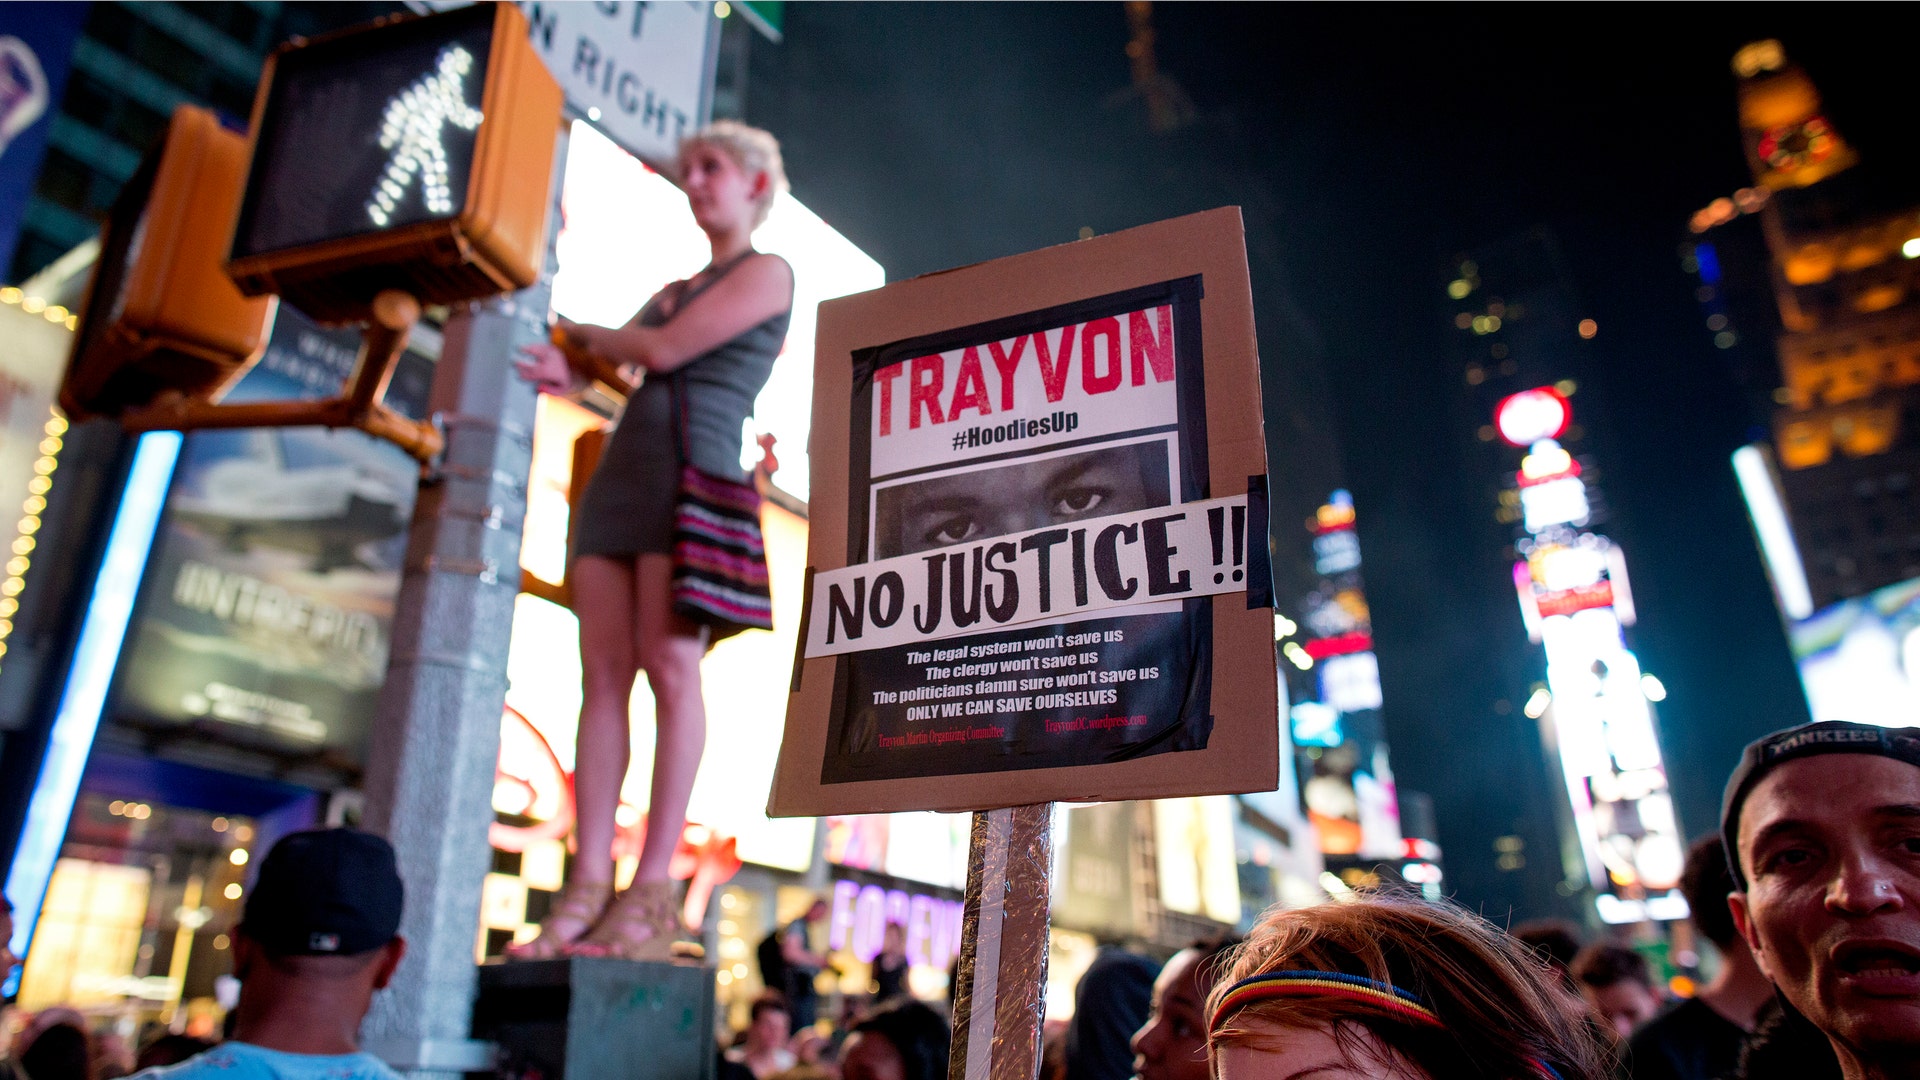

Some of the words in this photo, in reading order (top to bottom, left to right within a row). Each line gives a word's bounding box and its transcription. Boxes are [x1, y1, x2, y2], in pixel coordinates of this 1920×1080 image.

[572, 35, 689, 138] RIGHT
[872, 304, 1175, 437] TRAYVON
[952, 411, 1079, 450] #HoodiesUp
[826, 571, 905, 644] NO
[914, 513, 1192, 634] JUSTICE
[1207, 505, 1246, 584] !!
[907, 652, 931, 665] The
[933, 646, 968, 662] legal
[970, 641, 1022, 658] system
[1024, 635, 1064, 651] won't
[1066, 632, 1101, 647] save
[1104, 630, 1124, 642] us
[926, 667, 950, 680] The
[953, 662, 998, 676] clergy
[1000, 657, 1040, 673] won't
[1041, 654, 1077, 669] save
[1080, 652, 1099, 665] us
[873, 691, 897, 704] The
[899, 683, 973, 703] politicians
[975, 680, 1017, 695] damn
[1020, 677, 1053, 691] sure
[1056, 670, 1097, 687] won't
[1100, 668, 1136, 683] save
[1139, 667, 1159, 680] us
[906, 705, 940, 721] ONLY
[941, 703, 963, 717] WE
[965, 700, 993, 715] CAN
[996, 697, 1033, 713] SAVE
[1034, 689, 1118, 710] OURSELVES
[878, 733, 905, 750] Trayvon
[906, 728, 928, 745] Martin
[929, 726, 966, 746] Organizing
[967, 723, 1005, 740] Committee
[1769, 729, 1879, 755] YANKEES
